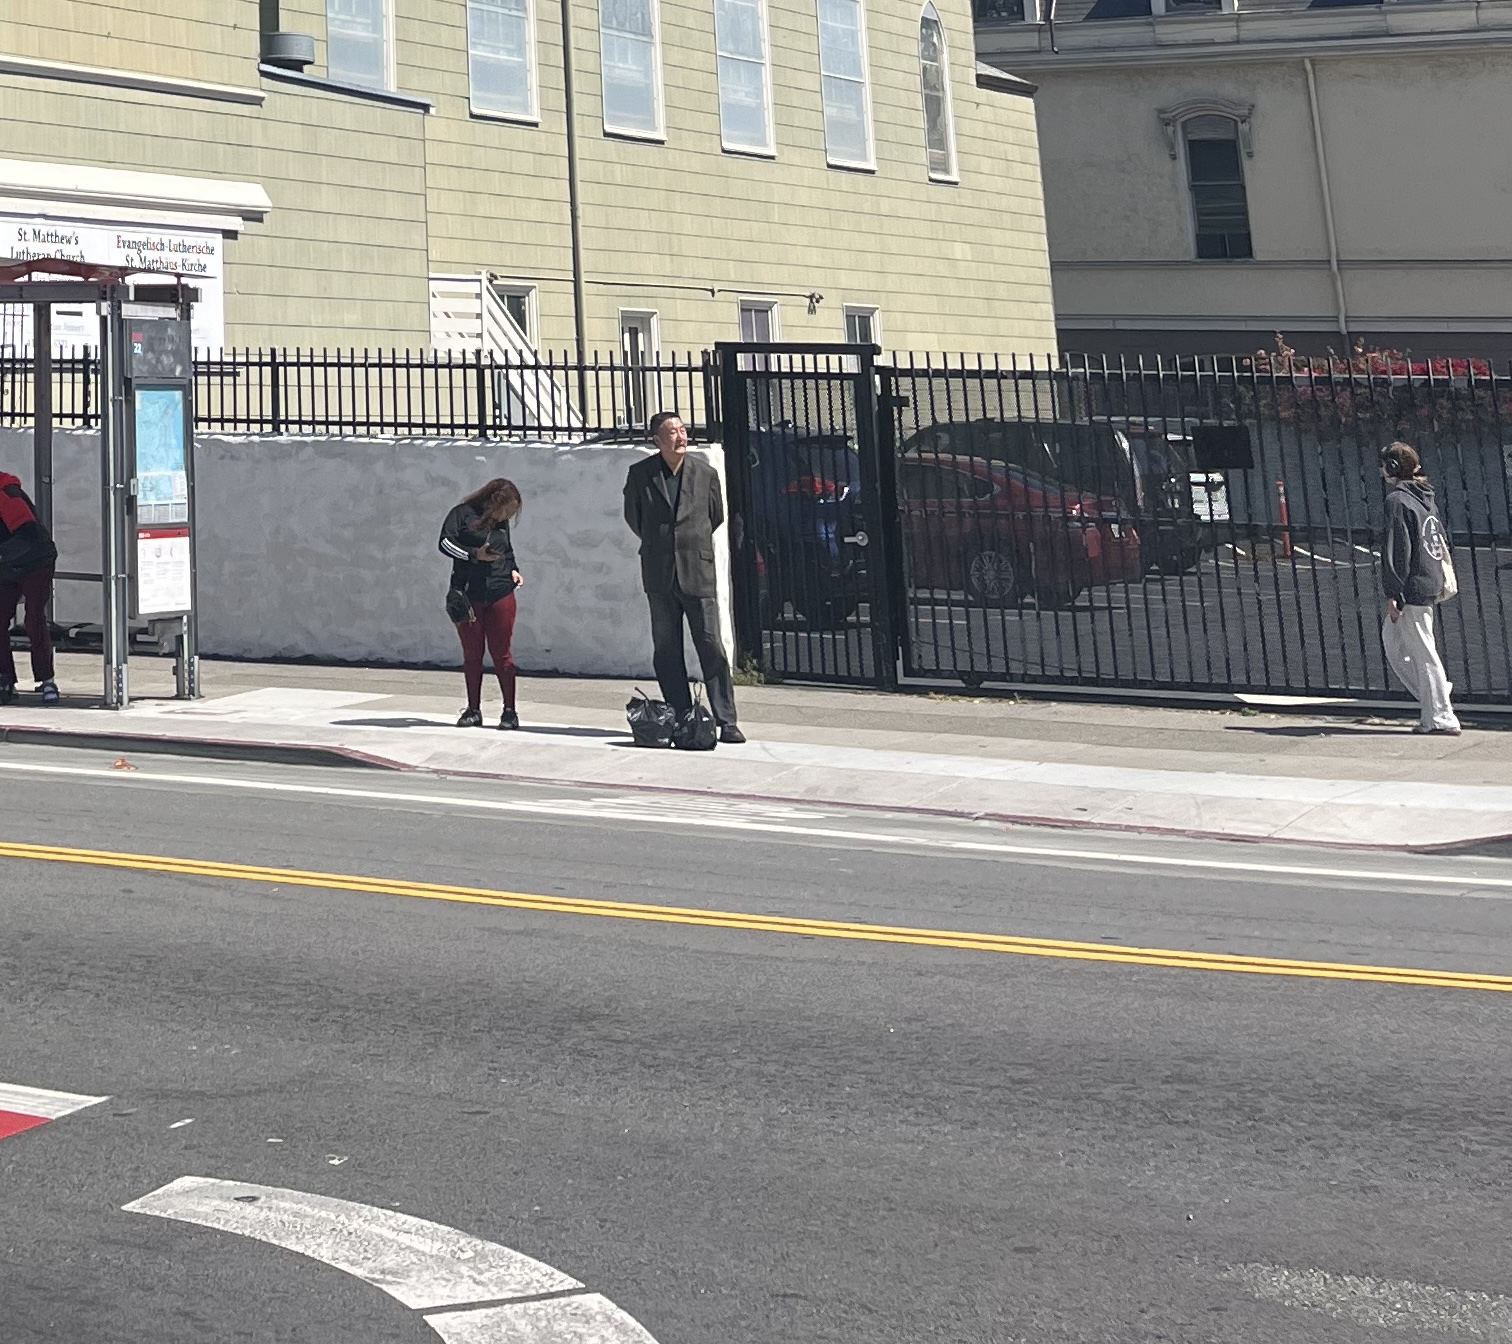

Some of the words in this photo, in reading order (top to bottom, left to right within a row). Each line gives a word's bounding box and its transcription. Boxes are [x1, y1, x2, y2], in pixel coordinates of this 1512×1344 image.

[17, 227, 31, 242] St.
[32, 228, 79, 246] Matthew's
[116, 235, 215, 256] Evangelisch-Lutherische
[133, 342, 142, 353] 22
